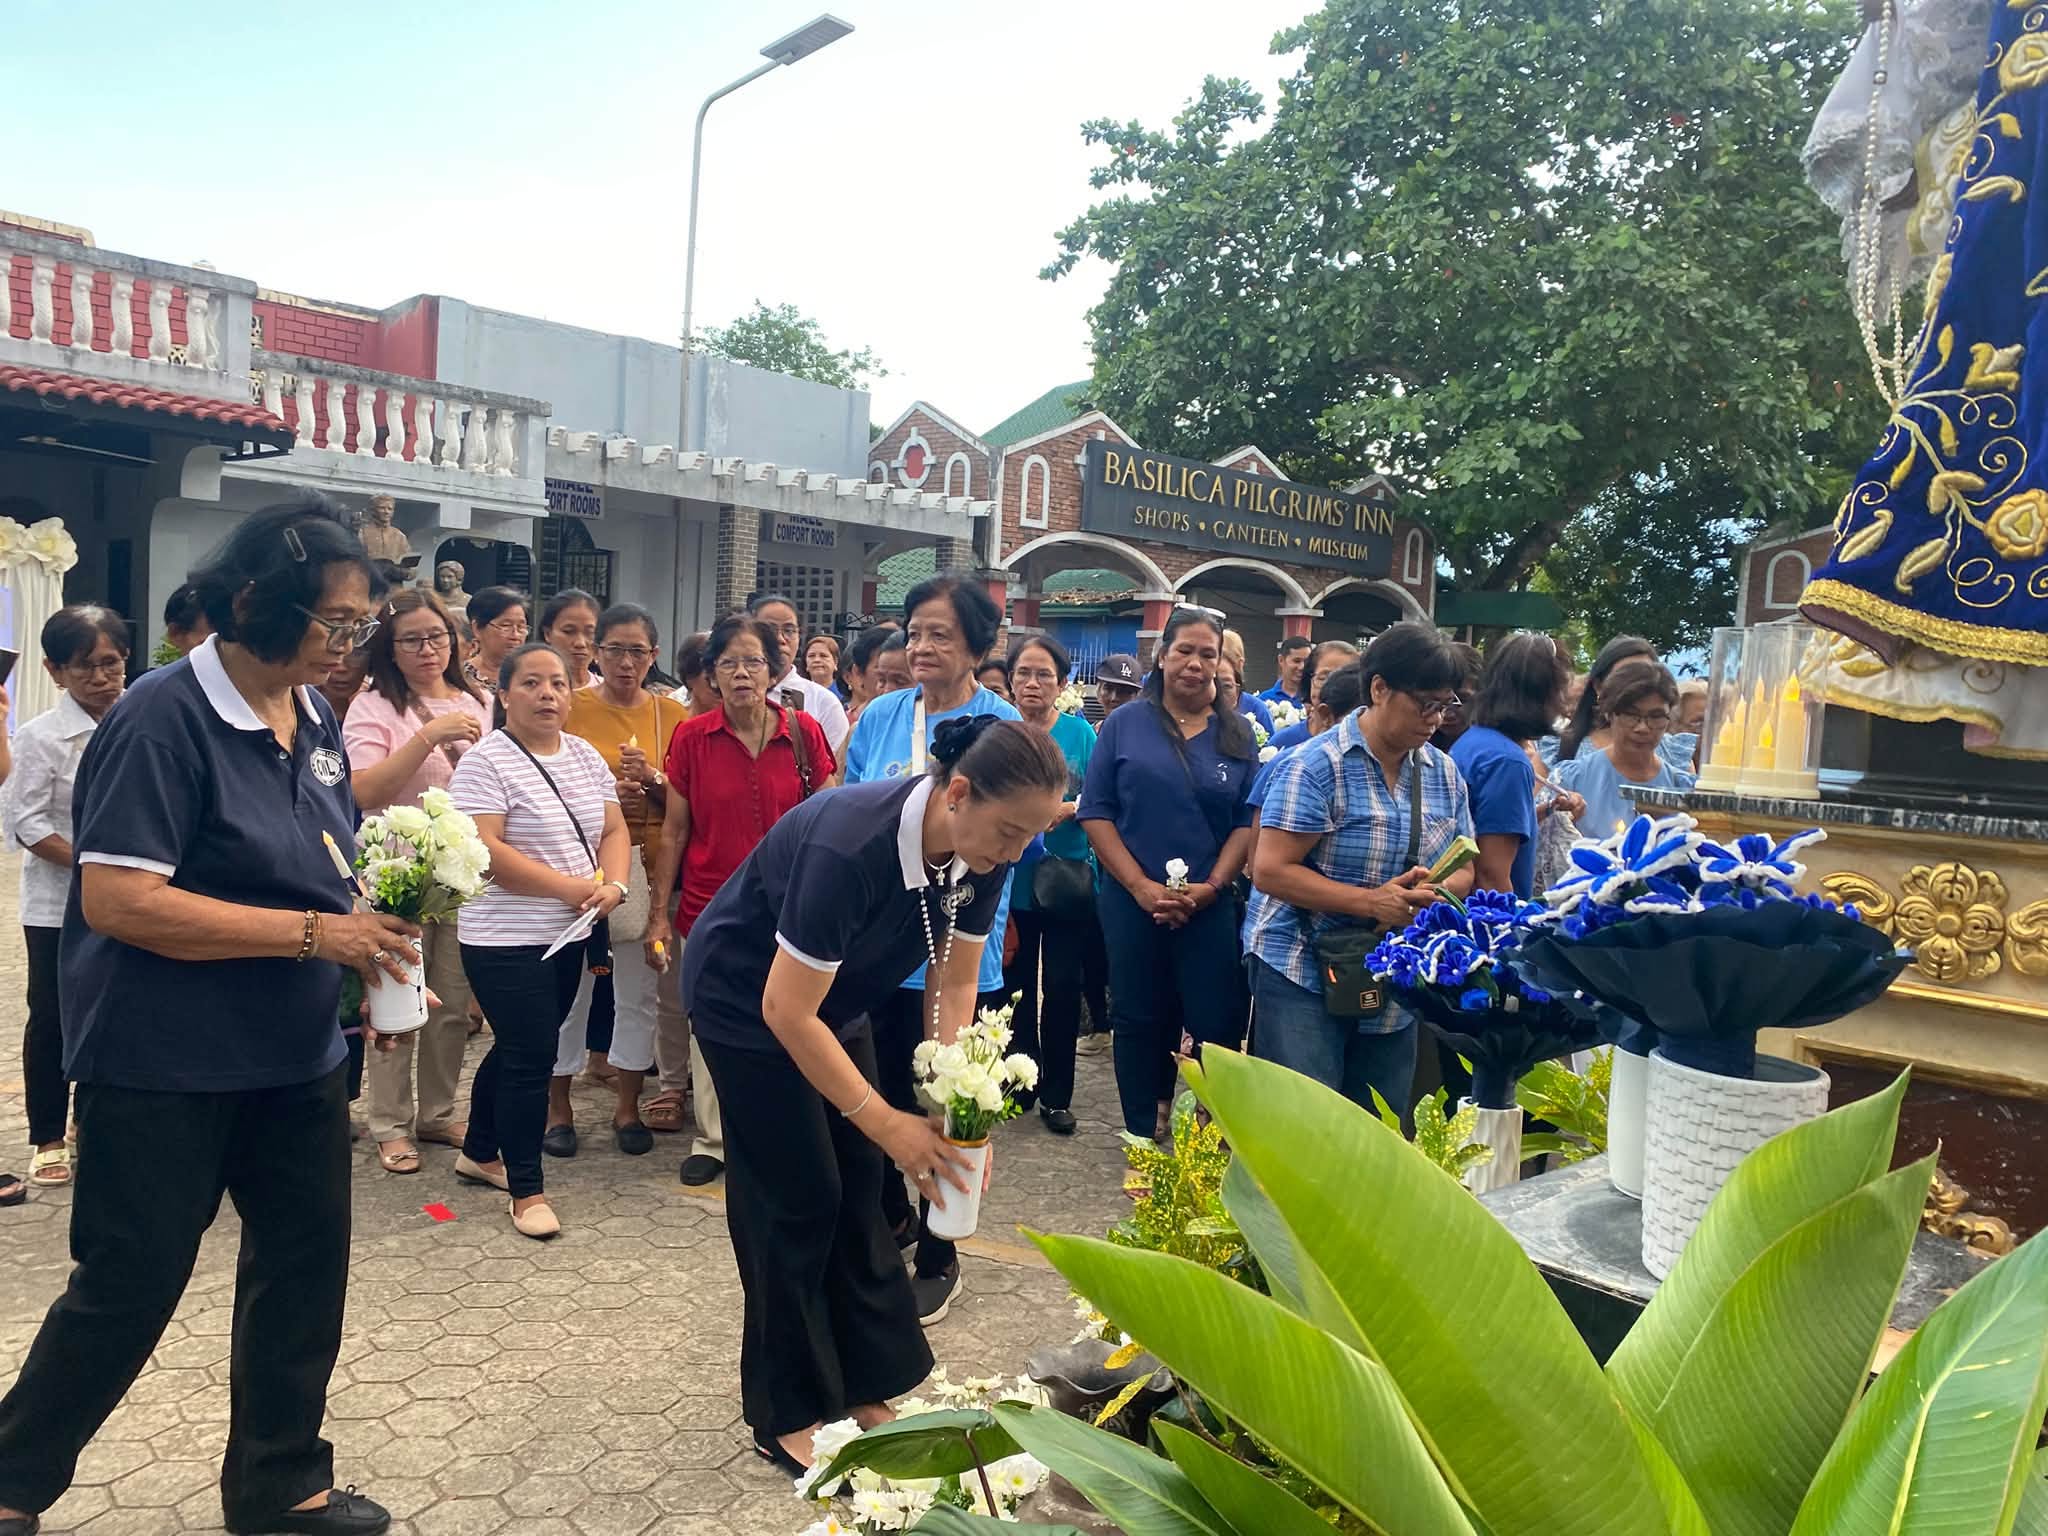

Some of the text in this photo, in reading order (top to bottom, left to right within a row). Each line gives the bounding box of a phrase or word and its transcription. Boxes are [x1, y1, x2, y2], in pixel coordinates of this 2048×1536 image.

[570, 495, 600, 515] ROOMS
[1104, 451, 1225, 506] BASILICA
[1354, 504, 1394, 536] INN
[777, 523, 834, 546] COMFORT ROOMS
[1134, 505, 1368, 561] SHOPS CANTEEN MUSEUM
[1120, 662, 1132, 678] LA
